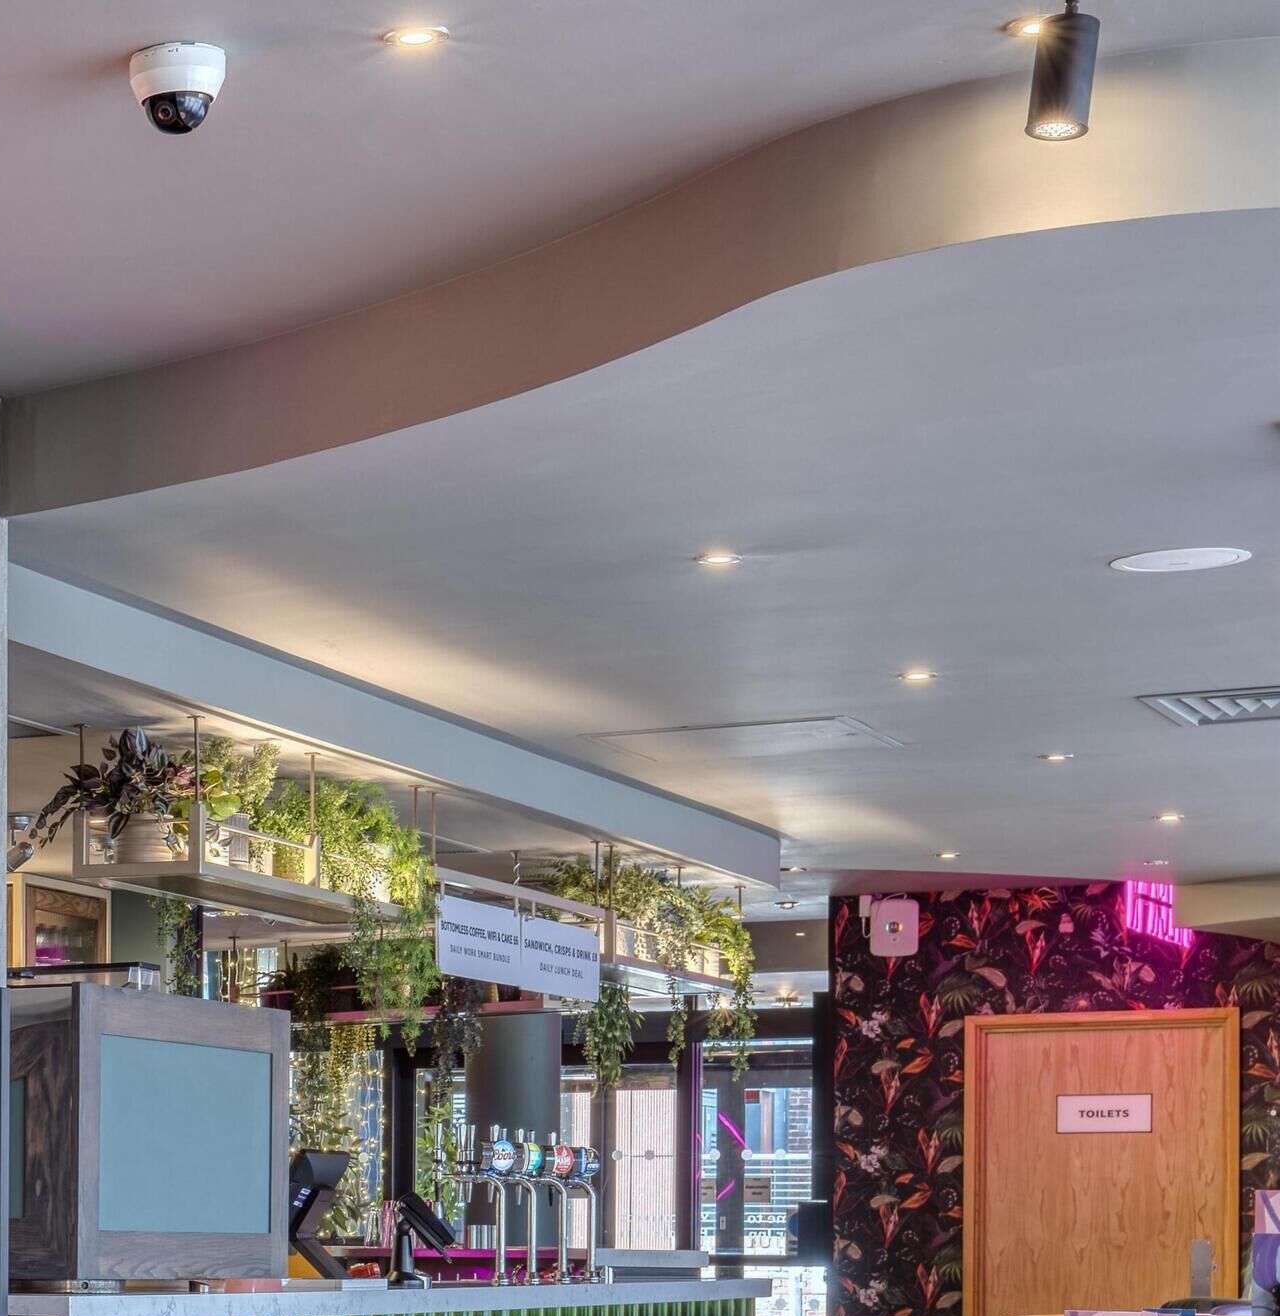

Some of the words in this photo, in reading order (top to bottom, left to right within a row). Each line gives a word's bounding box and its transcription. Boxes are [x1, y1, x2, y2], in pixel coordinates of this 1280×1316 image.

[441, 920, 468, 936] BOTTOMLESS
[469, 926, 487, 939] COFFEE,
[497, 932, 501, 942] &
[501, 932, 513, 944] CAKE
[450, 944, 462, 954] DAILY
[464, 947, 476, 957] WORK
[477, 950, 492, 960] SMART
[493, 952, 510, 963] BUNDLE
[524, 938, 553, 954] SANDWICH,
[554, 944, 571, 957] CRISPS
[572, 948, 576, 958] &
[576, 949, 591, 960] DRINK
[539, 962, 553, 972] DAILY
[555, 964, 570, 976] LUNCH
[571, 968, 583, 979] DEAL
[1078, 1108, 1130, 1119] TOILETS
